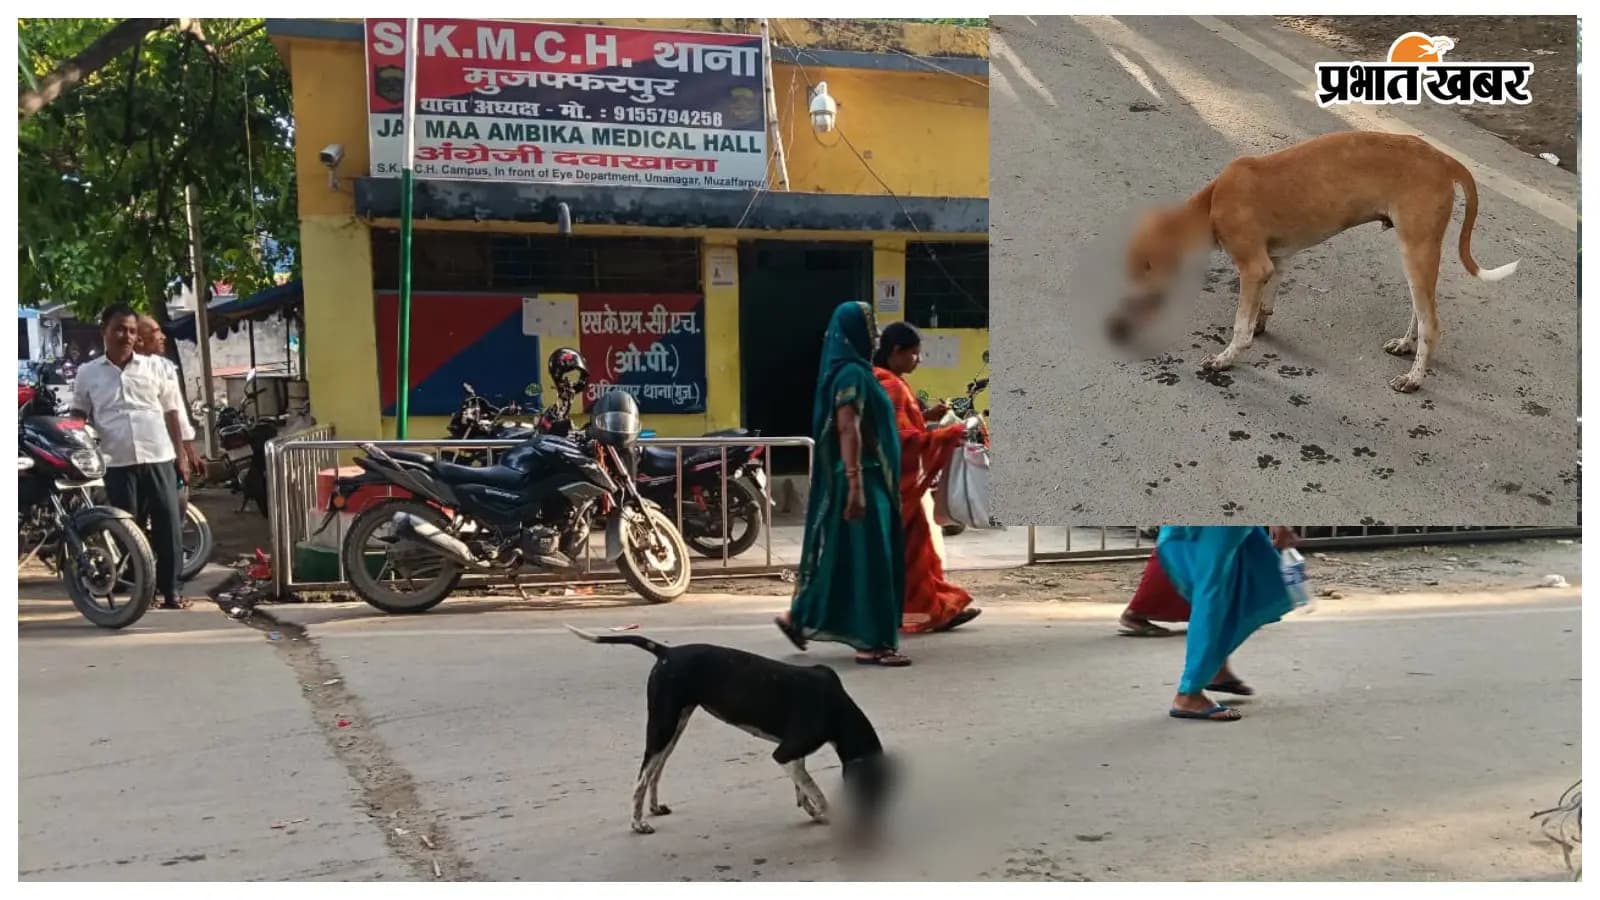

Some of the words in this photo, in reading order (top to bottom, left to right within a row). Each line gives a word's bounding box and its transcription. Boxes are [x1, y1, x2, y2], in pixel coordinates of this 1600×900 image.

[373, 22, 632, 68] SK.M.C.H.
[653, 42, 760, 77] थाना
[461, 67, 680, 104] मुजफ्फरपुर
[613, 105, 723, 128] 9155794258
[376, 118, 405, 138] JA
[425, 120, 480, 140] MAA
[487, 122, 584, 145] AMBIKA
[592, 127, 697, 151] MEDICAL
[703, 133, 762, 153] HALL
[376, 162, 438, 175] S.K.C.H.
[441, 166, 491, 178] Campus,
[494, 167, 505, 176] In
[507, 168, 535, 178] front
[538, 169, 549, 179] of
[552, 169, 573, 181] Eye
[575, 171, 642, 184] Department,
[415, 142, 544, 164] अंग्रेजी
[553, 151, 719, 173] दवाखाना
[606, 341, 680, 379] (ओ.पी.)
